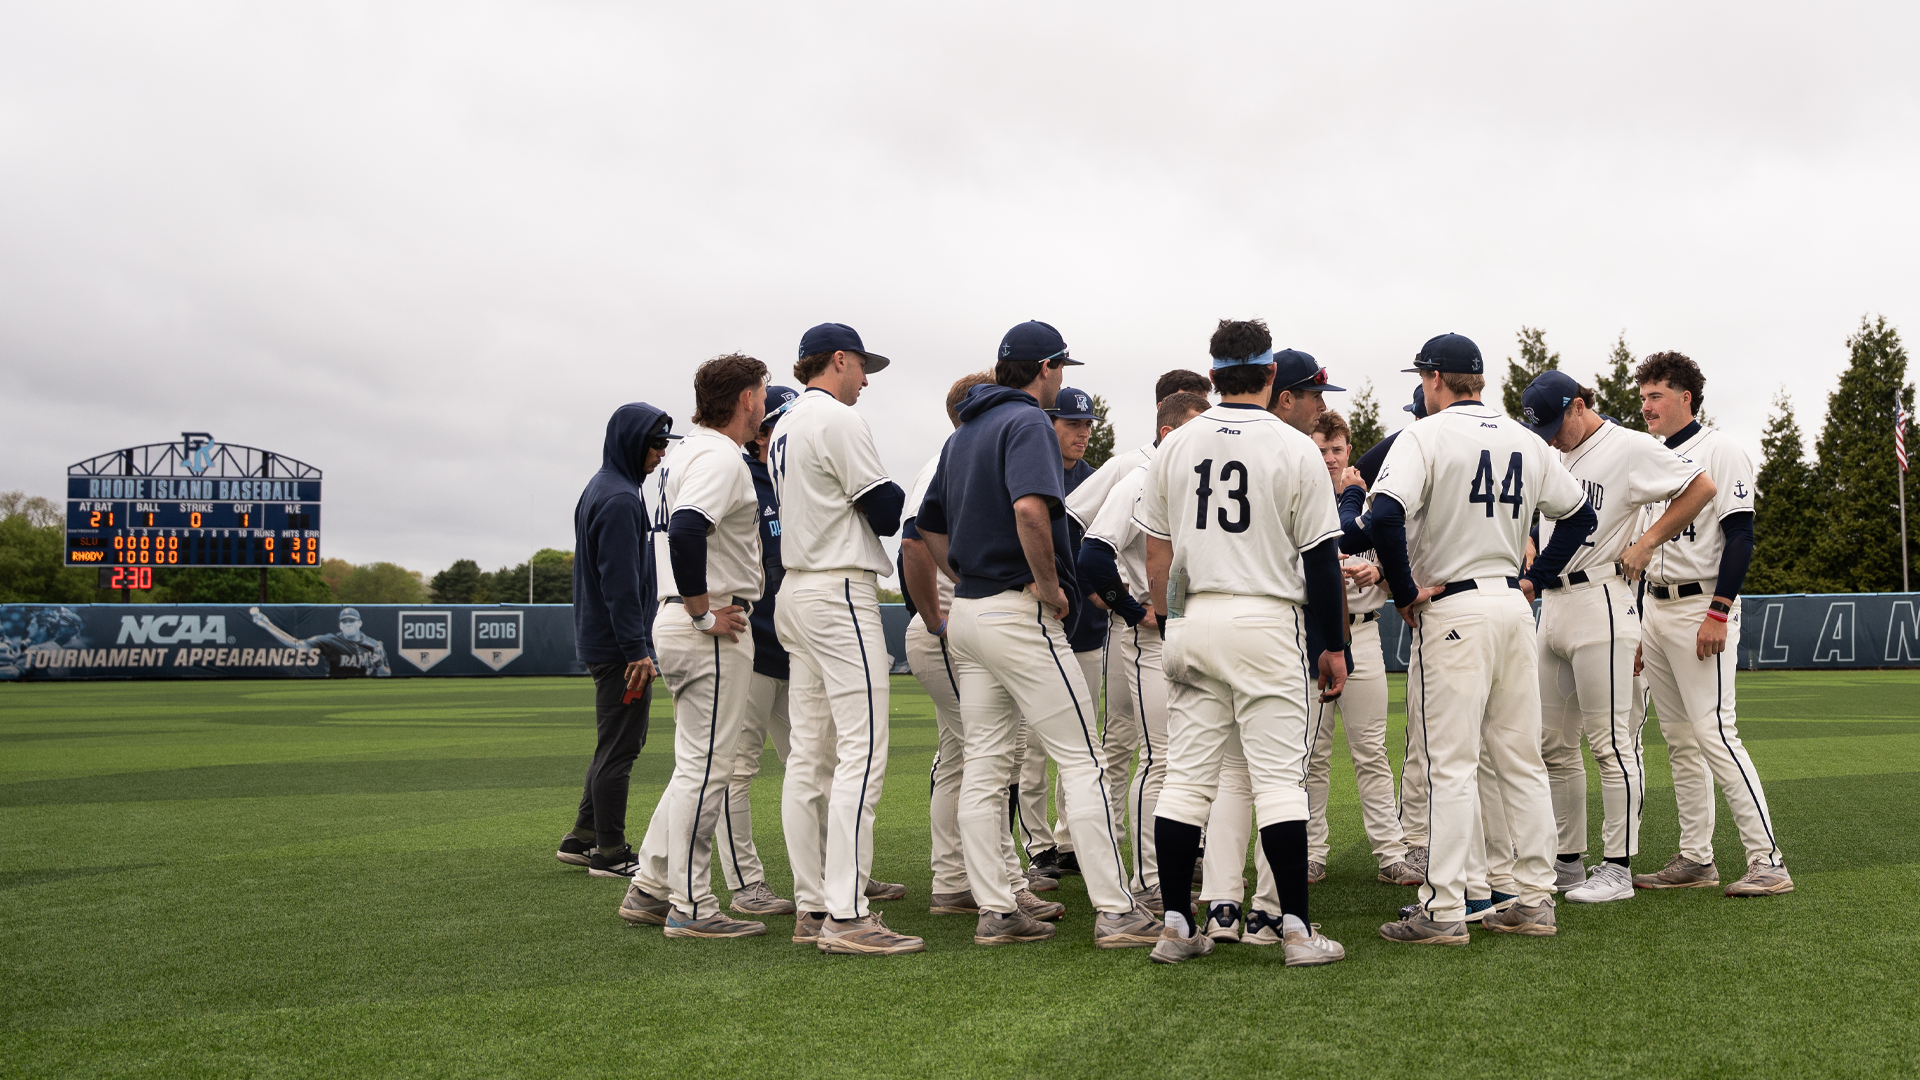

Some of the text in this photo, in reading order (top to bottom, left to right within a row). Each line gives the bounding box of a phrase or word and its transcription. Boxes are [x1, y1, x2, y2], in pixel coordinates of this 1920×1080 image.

[769, 433, 788, 508] 17
[89, 479, 301, 501] RHODE ISLAND BASEBALL
[1469, 449, 1523, 519] 44
[1194, 458, 1251, 534] 13
[79, 502, 114, 511] AT BAT
[136, 502, 160, 512] BALL
[180, 503, 214, 513] STRIKE
[233, 504, 254, 513] OUT
[285, 504, 302, 514] H/E
[90, 511, 114, 528] 21
[148, 512, 154, 527] 1
[190, 512, 202, 529] 0
[243, 513, 249, 528] 1
[118, 529, 320, 538] 1 2 3 4 5 6 7 8 9 10 RUNS HITS ERR
[80, 536, 316, 551] SLU 0 0 0 0 0 0 3 0
[71, 550, 316, 565] RHODY 1 0 0 0 0 1 4 0
[404, 622, 447, 639] 2005
[479, 622, 517, 639] 2016
[25, 648, 321, 668] TOURNAMENT APPEARANCES
